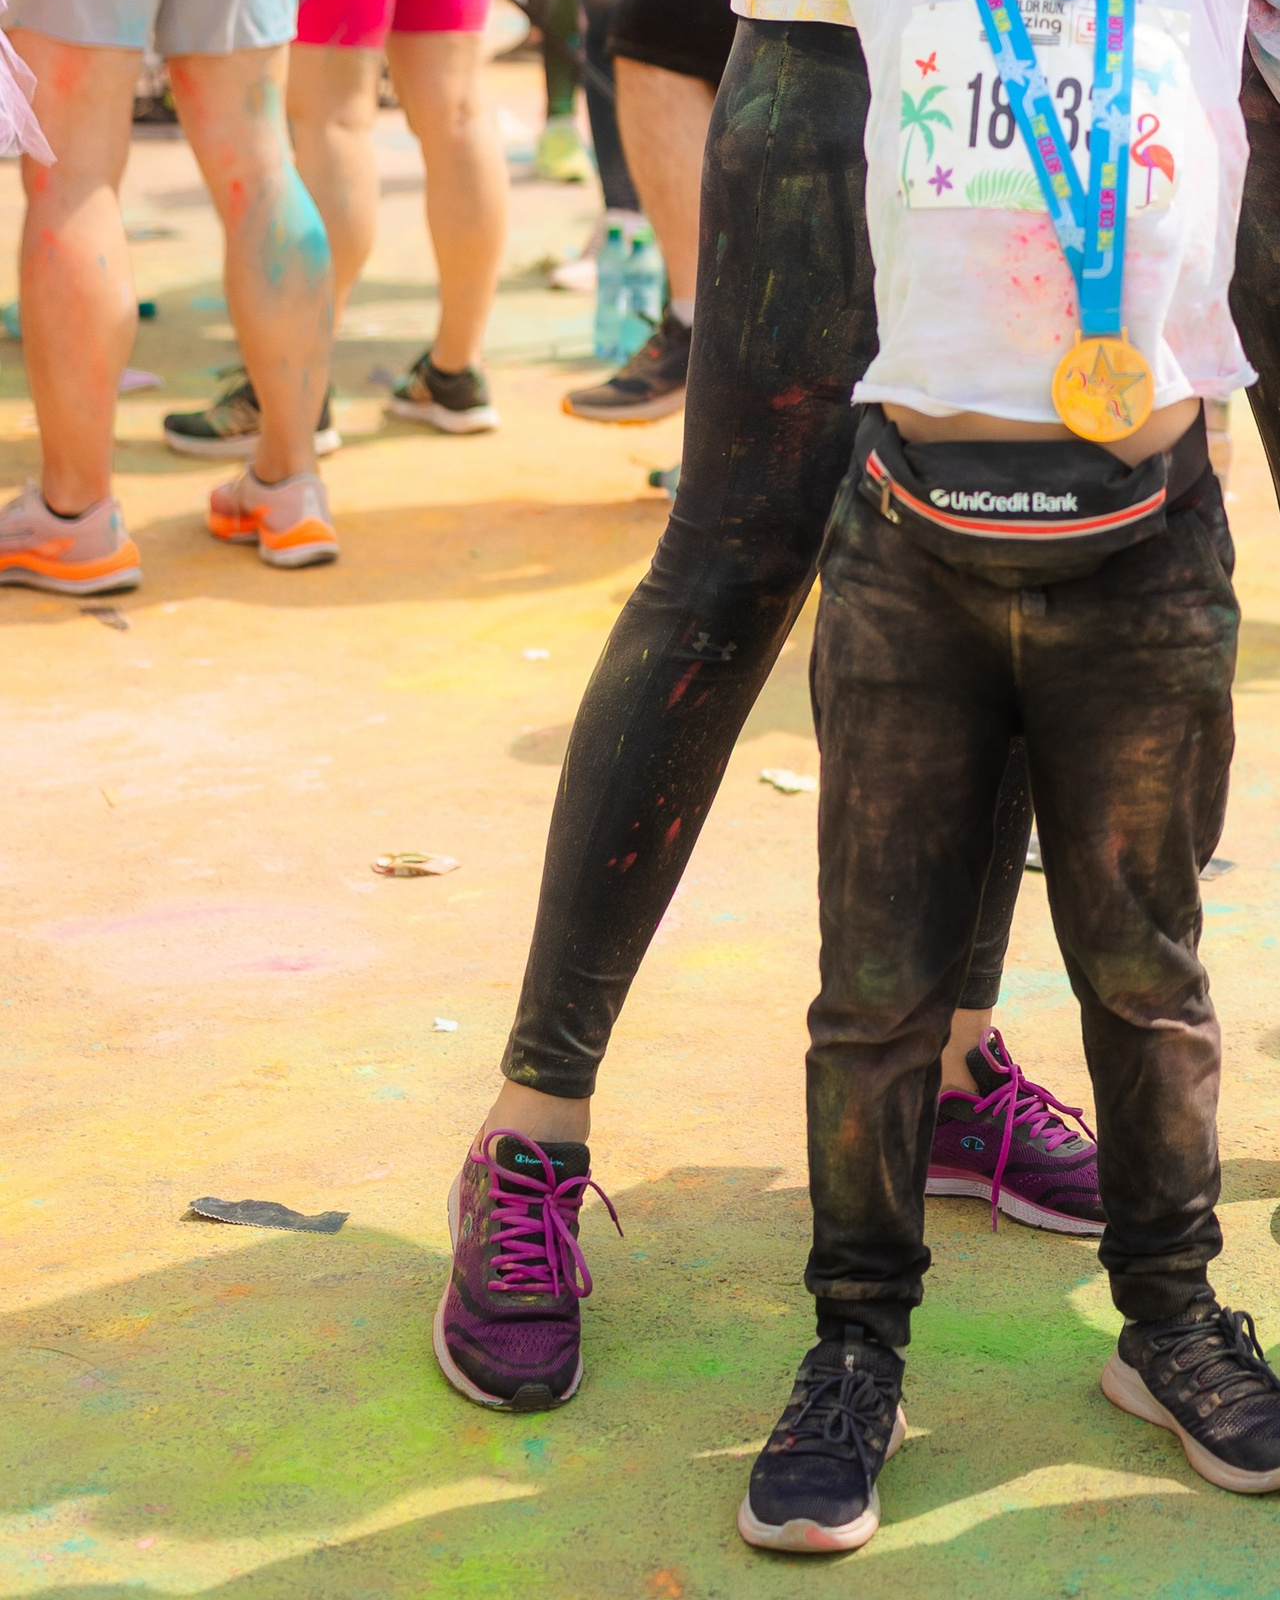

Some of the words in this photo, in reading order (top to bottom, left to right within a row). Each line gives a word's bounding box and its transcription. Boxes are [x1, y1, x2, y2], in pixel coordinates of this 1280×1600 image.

[1025, 15, 1063, 35] zing
[1107, 16, 1124, 52] COLOR
[1037, 136, 1063, 176] COLOR
[1099, 188, 1116, 229] COLOR
[951, 490, 1031, 513] UniCredit
[1032, 491, 1079, 513] Bank
